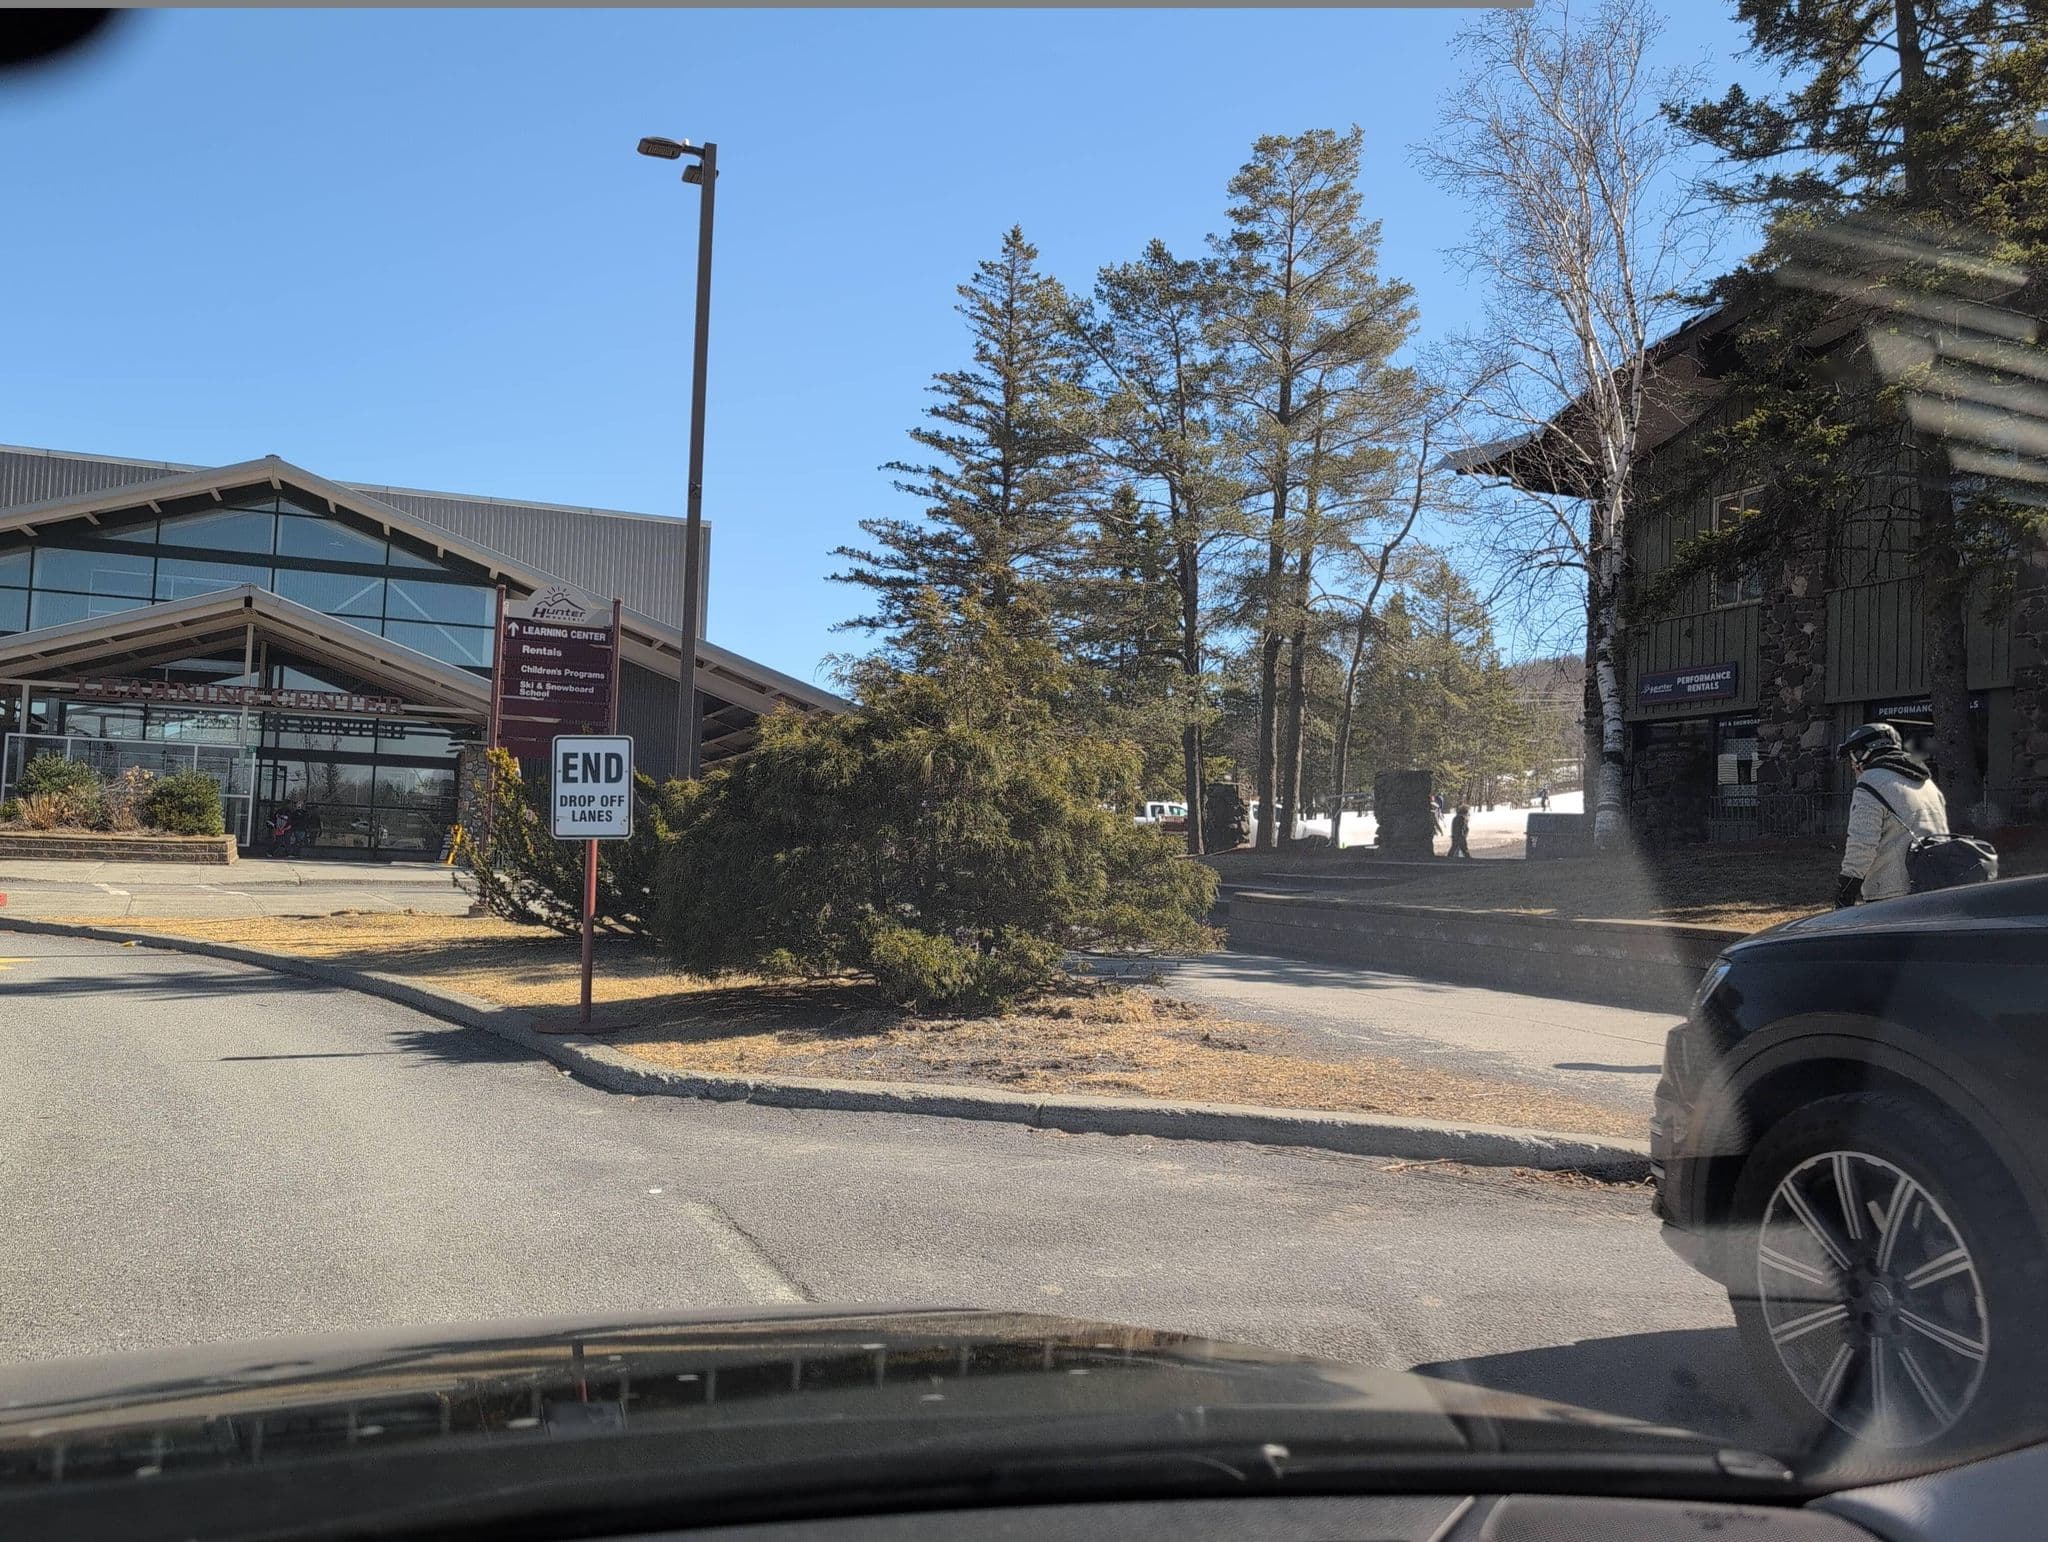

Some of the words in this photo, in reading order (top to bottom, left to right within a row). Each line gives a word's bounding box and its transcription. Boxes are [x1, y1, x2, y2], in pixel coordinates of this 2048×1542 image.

[522, 625, 568, 639] LEARNING
[570, 630, 606, 642] CENTER
[522, 645, 562, 657] Rentals
[520, 665, 562, 676] Children's
[564, 668, 605, 680] Programs
[1677, 671, 1731, 685] PERFORMANCE
[519, 681, 534, 689] Ski
[536, 682, 543, 690] &
[545, 683, 595, 694] Snowboard
[519, 688, 550, 698] School
[1688, 682, 1719, 692] RENTALS
[75, 676, 261, 706] LEARNING
[271, 688, 404, 715] CENTER
[1879, 704, 1933, 715] PERFORMANC
[561, 752, 624, 784] END
[559, 795, 596, 807] DROP
[600, 795, 625, 807] OFF
[571, 810, 613, 822] LANES
